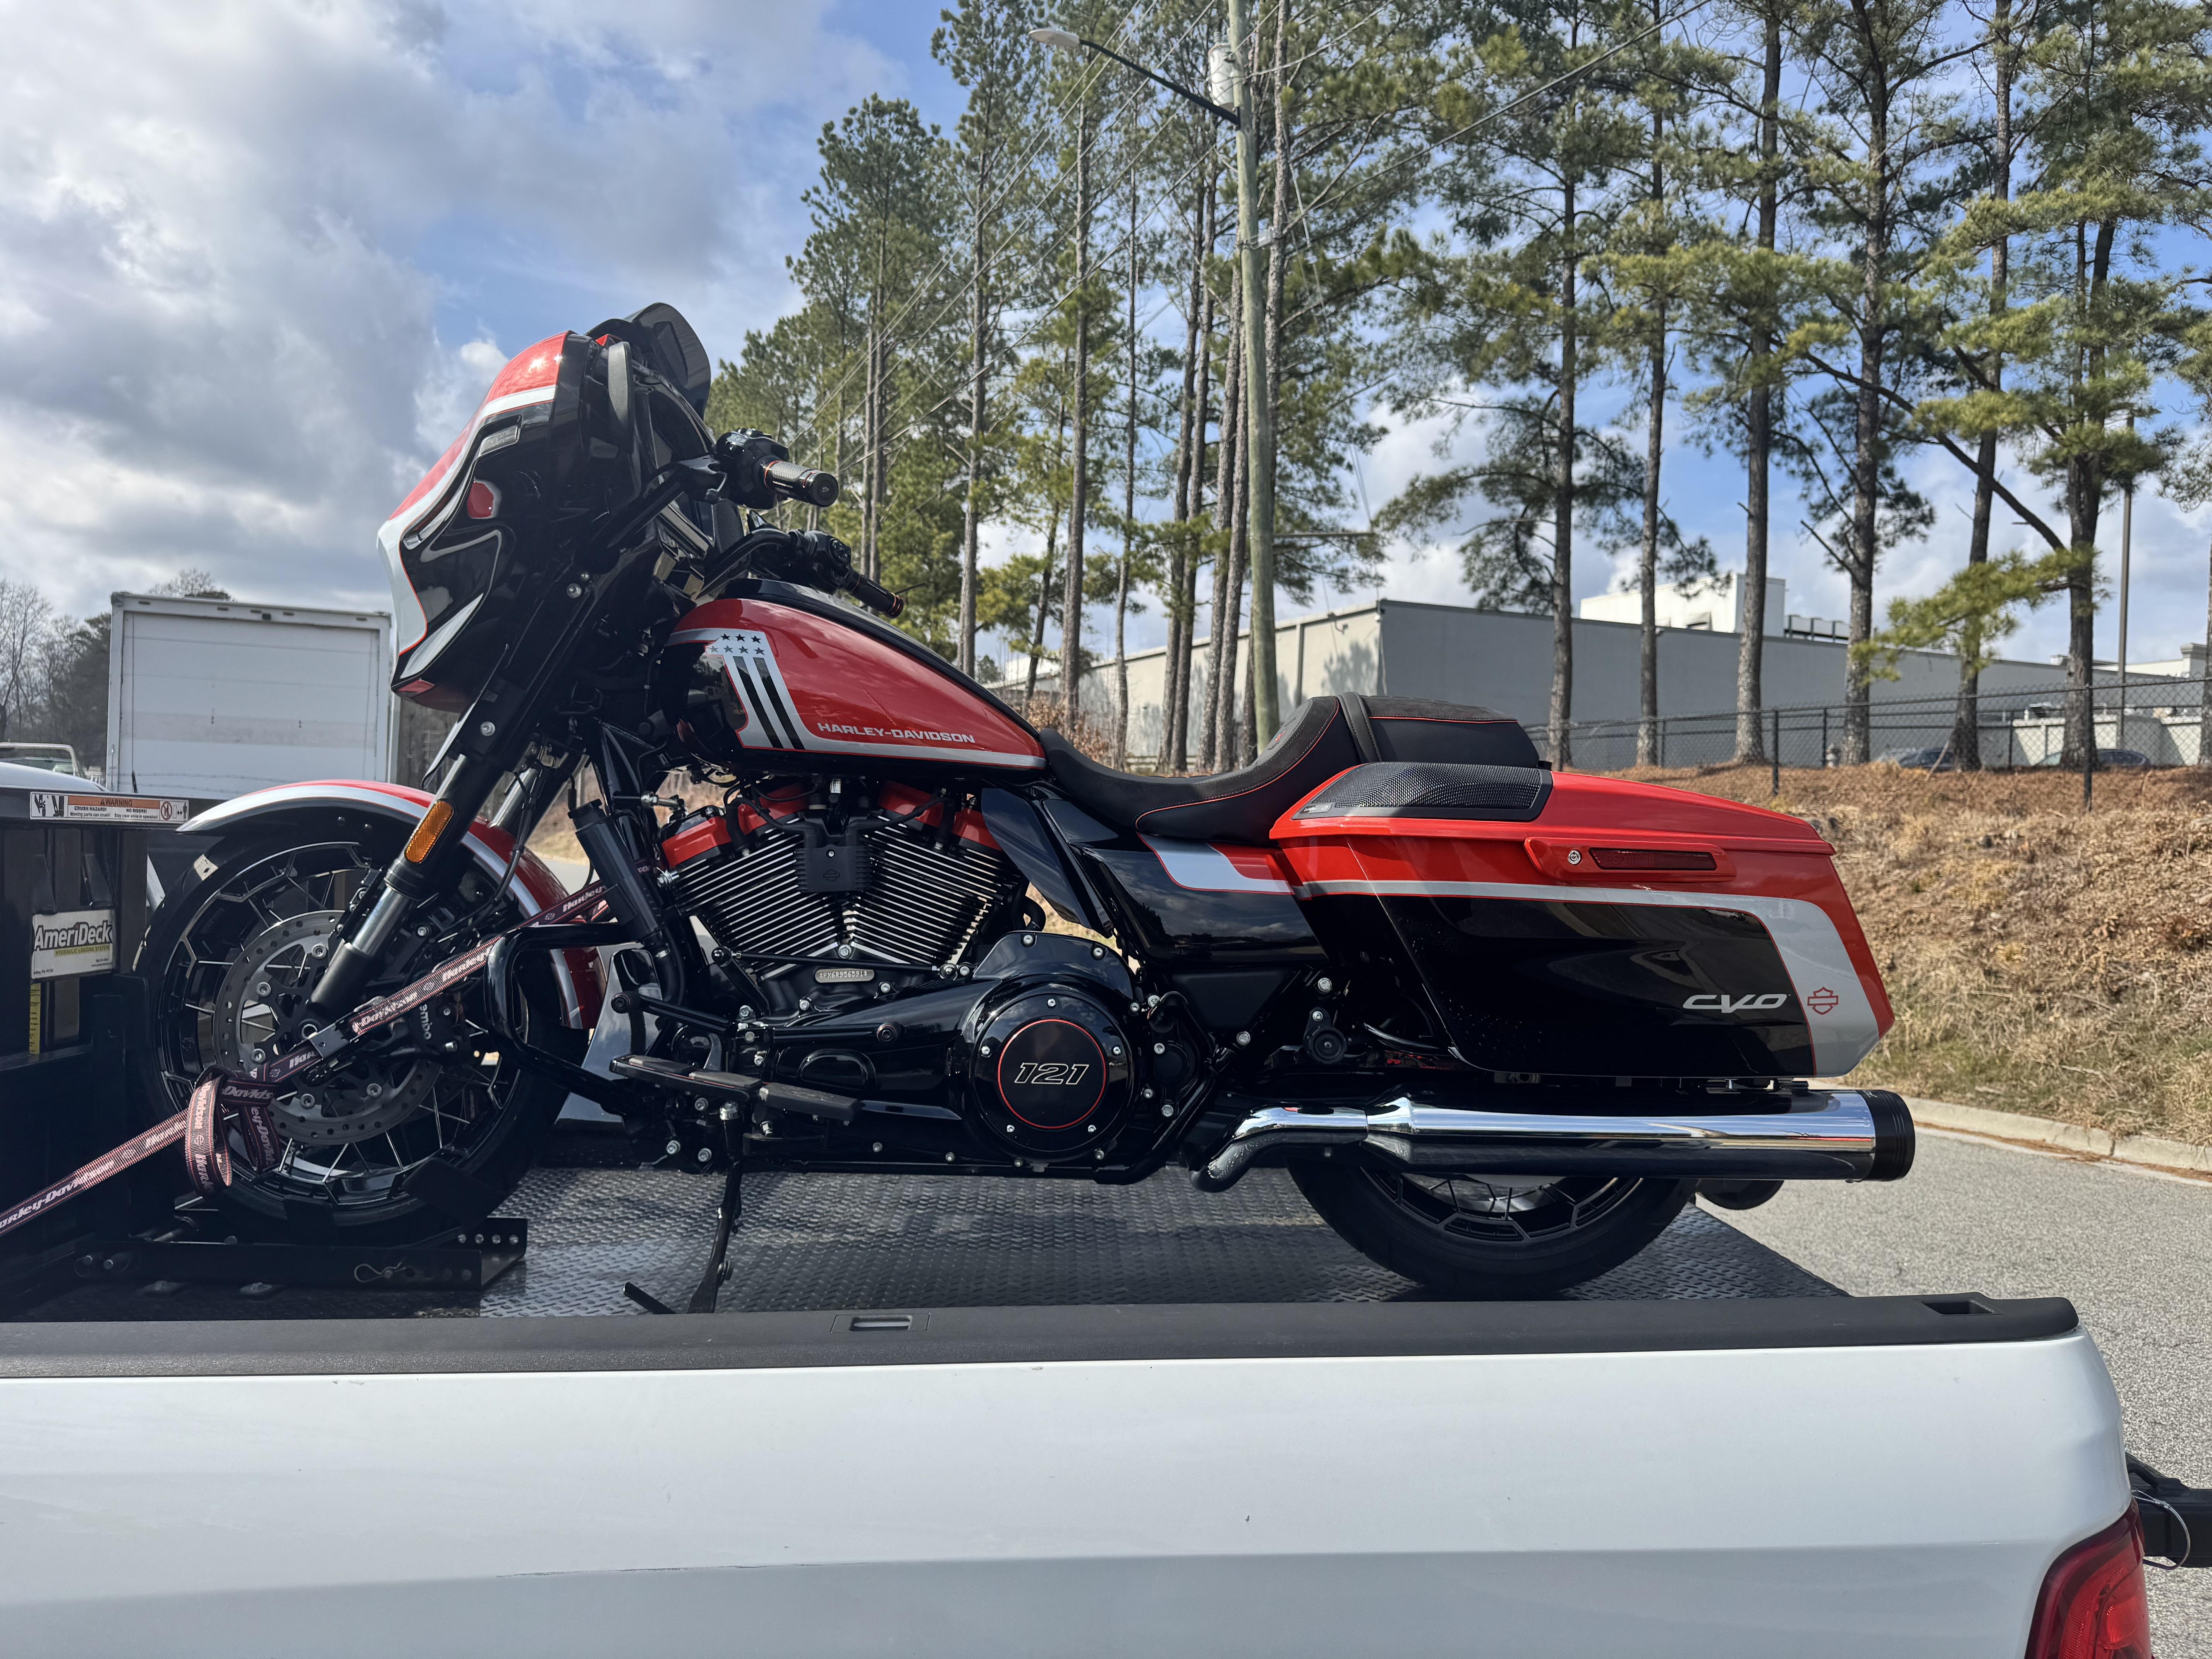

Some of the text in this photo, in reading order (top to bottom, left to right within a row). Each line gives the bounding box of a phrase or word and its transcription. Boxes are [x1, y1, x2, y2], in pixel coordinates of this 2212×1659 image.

[817, 723, 975, 743] HARLEY-DAVIDSON
[105, 799, 132, 807] WARNING
[34, 920, 112, 951] AmeriDeck
[1683, 994, 1787, 1013] CVO
[419, 1004, 433, 1040] embo
[1014, 1062, 1089, 1085] 121
[0, 1160, 115, 1228] arley-Davidson
